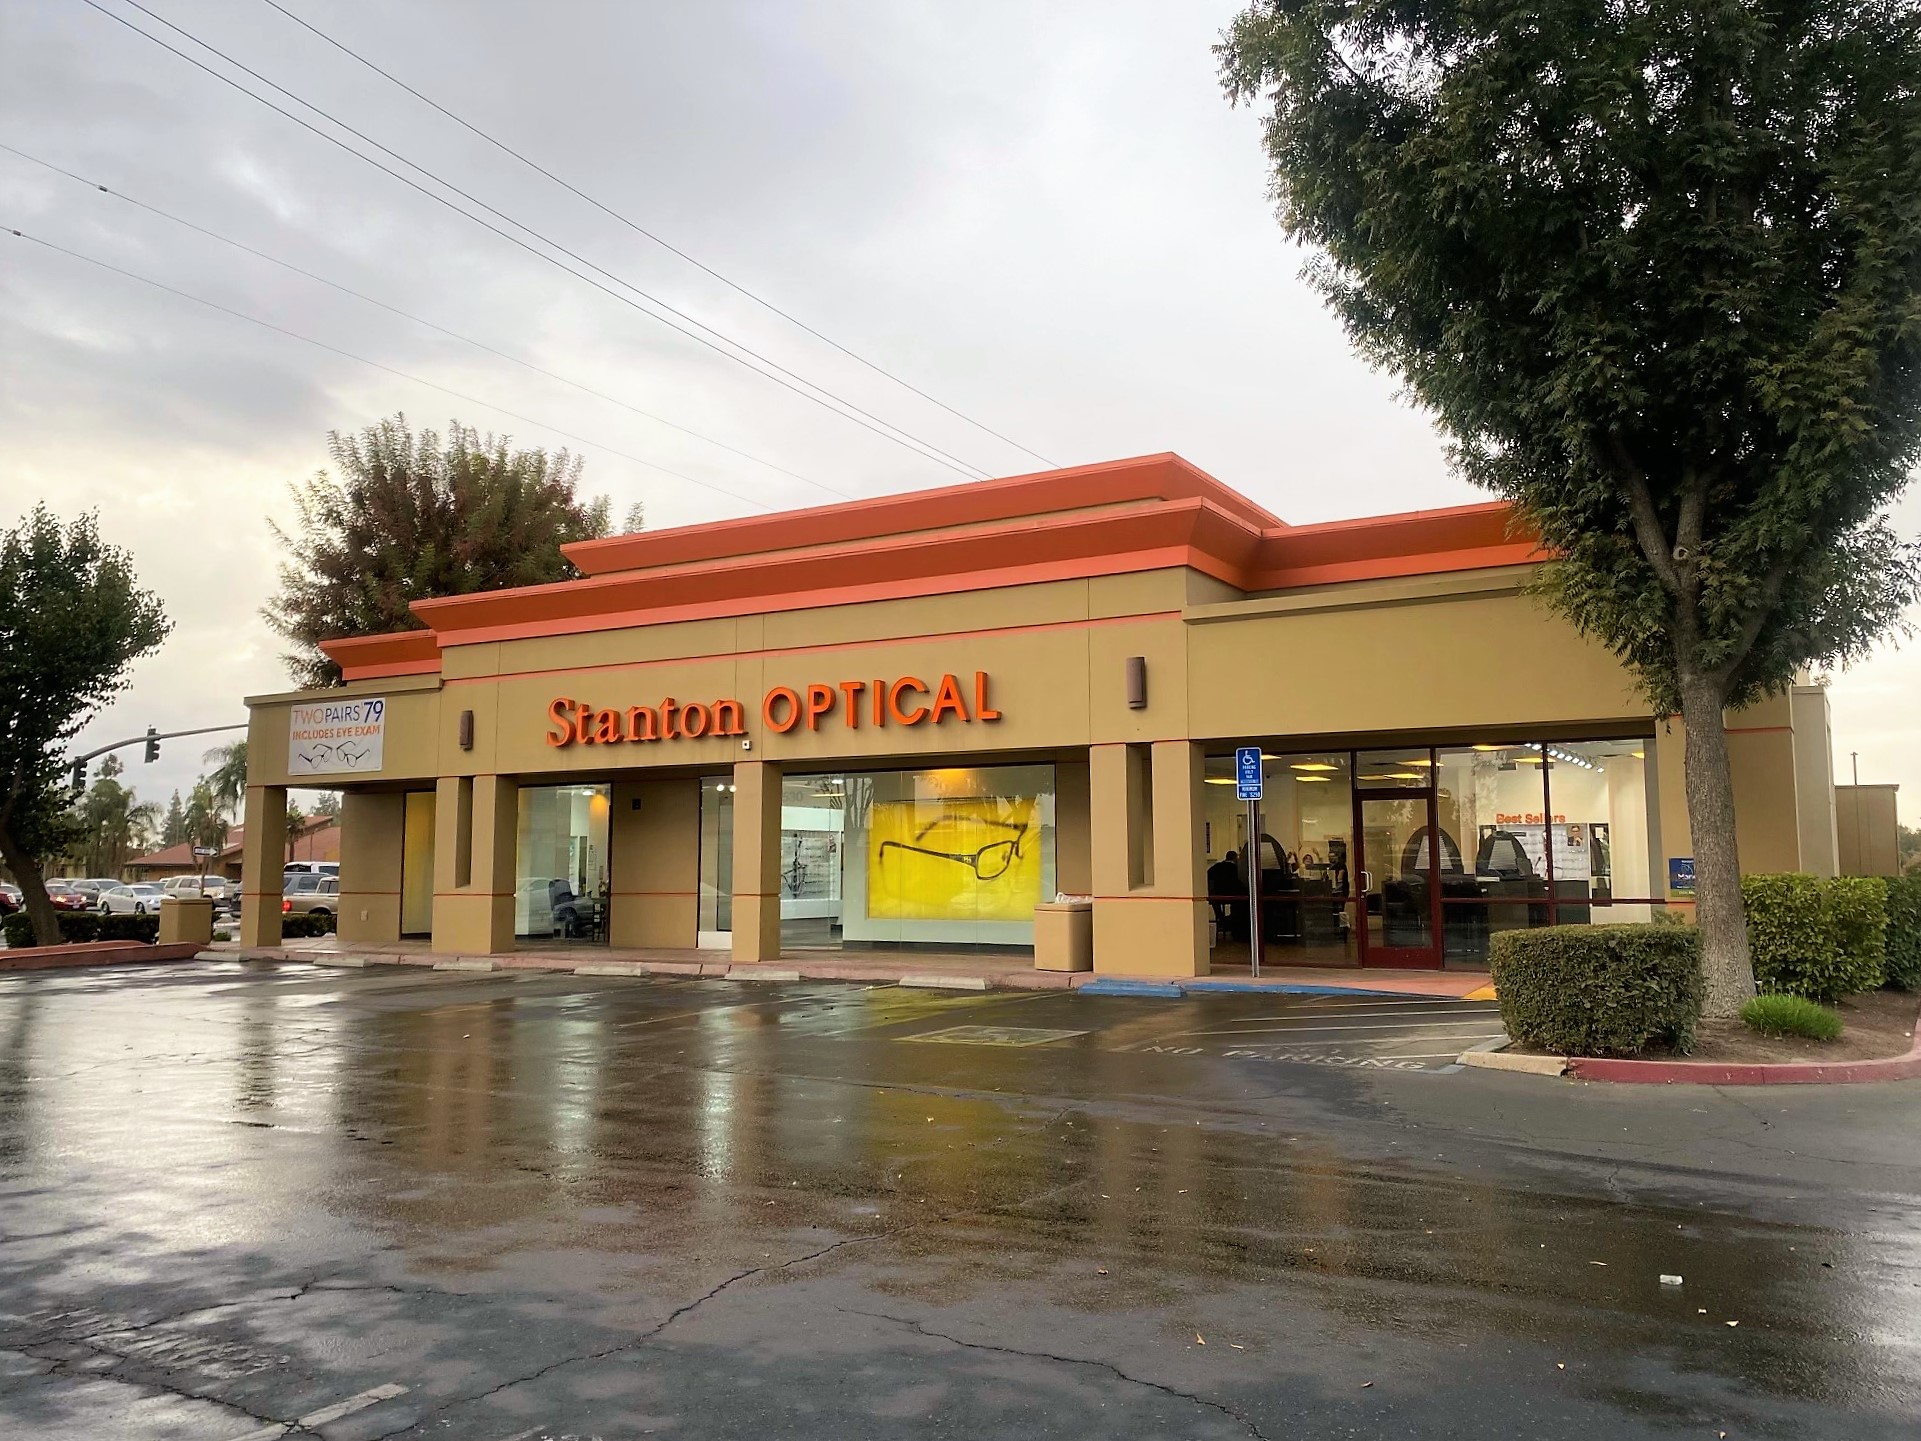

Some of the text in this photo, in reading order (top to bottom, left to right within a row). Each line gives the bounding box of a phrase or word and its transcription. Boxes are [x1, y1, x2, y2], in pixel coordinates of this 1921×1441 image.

[547, 671, 1002, 748] Stanton OPTICAL
[292, 725, 380, 740] INCLUDES EYE EXAM
[1496, 813, 1523, 824] Best
